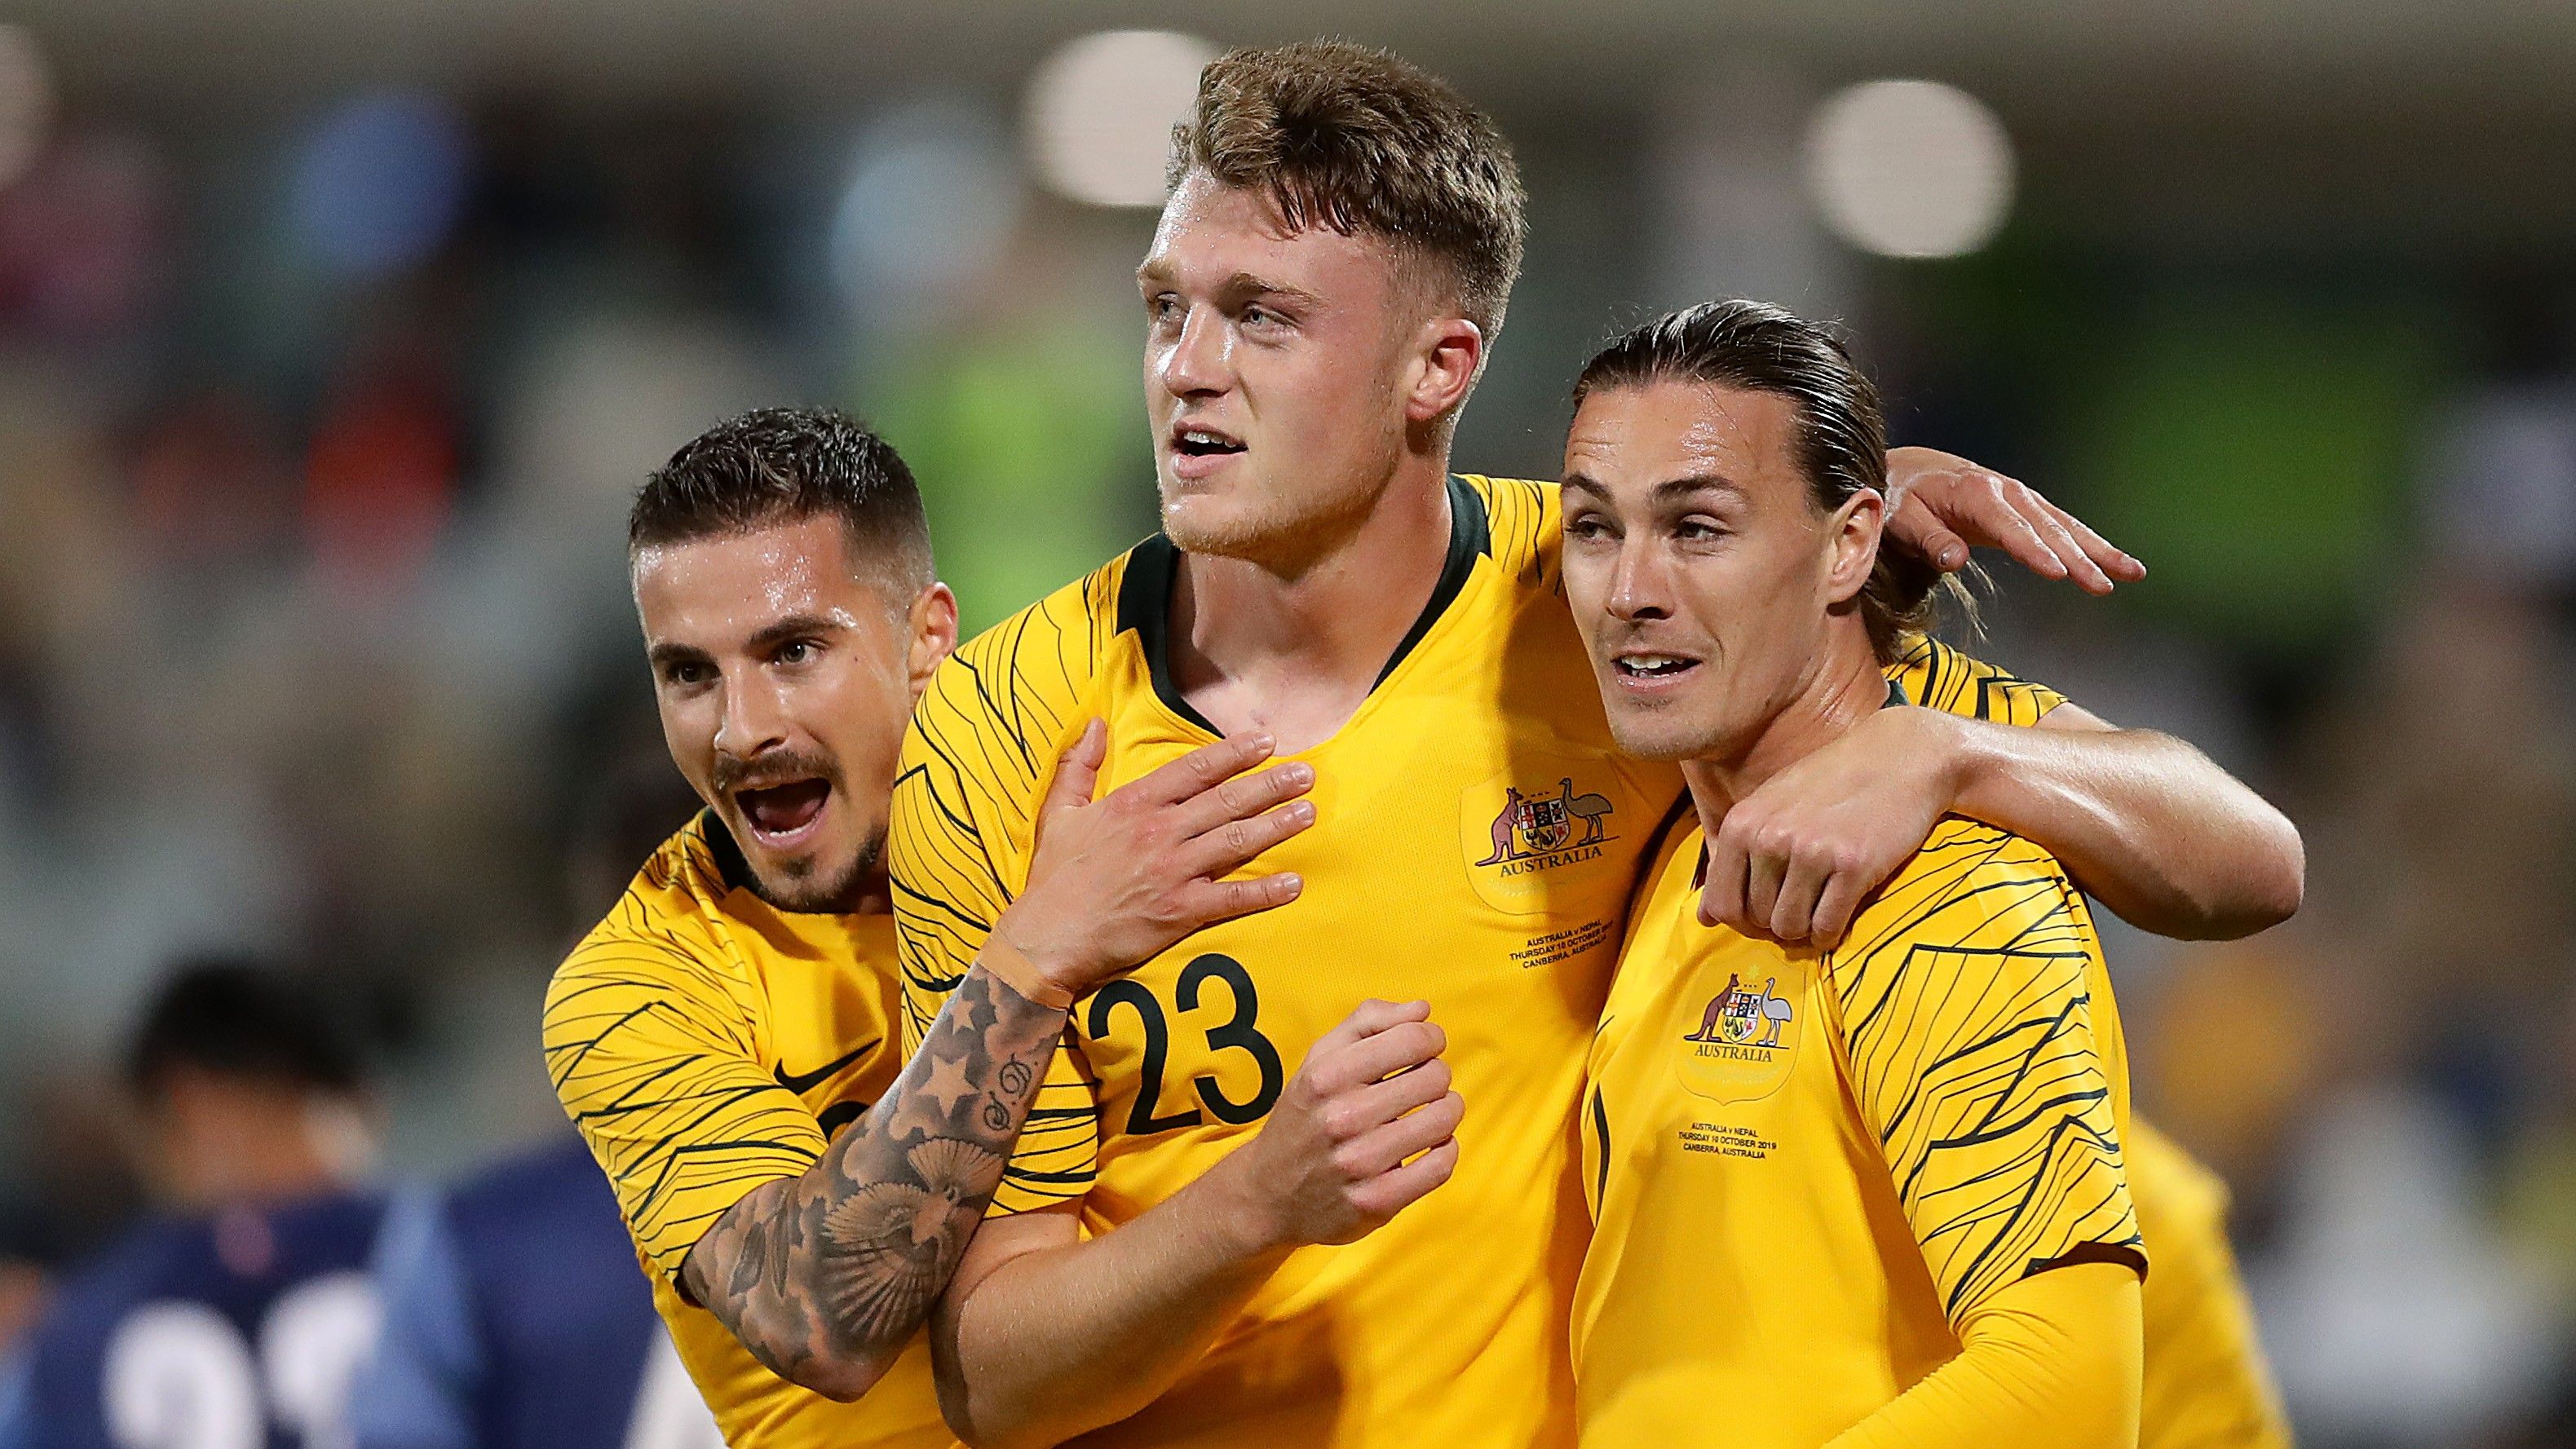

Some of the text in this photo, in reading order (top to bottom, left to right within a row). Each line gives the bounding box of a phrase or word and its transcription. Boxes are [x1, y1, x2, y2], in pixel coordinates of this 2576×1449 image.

[1500, 845, 1602, 877] AUSTRALIA
[1527, 930, 1573, 948] AUSTRALIA
[1580, 919, 1602, 933] NEPAL
[1571, 933, 1607, 954] AUSTRALIA
[1509, 944, 1556, 961] THURSDAY
[1566, 928, 1601, 948] OCTOBER
[1087, 952, 1284, 1136] 23
[1695, 1044, 1772, 1062] AUSTRALIA
[1678, 1131, 1709, 1142] THURSDAY
[1720, 1136, 1756, 1147] OCTOBER
[1757, 1141, 1777, 1150] 2019
[1692, 1122, 1726, 1133] AUSTRALIA
[1734, 1127, 1759, 1138] NEPAL
[1722, 1147, 1765, 1159] AUSTRALIA
